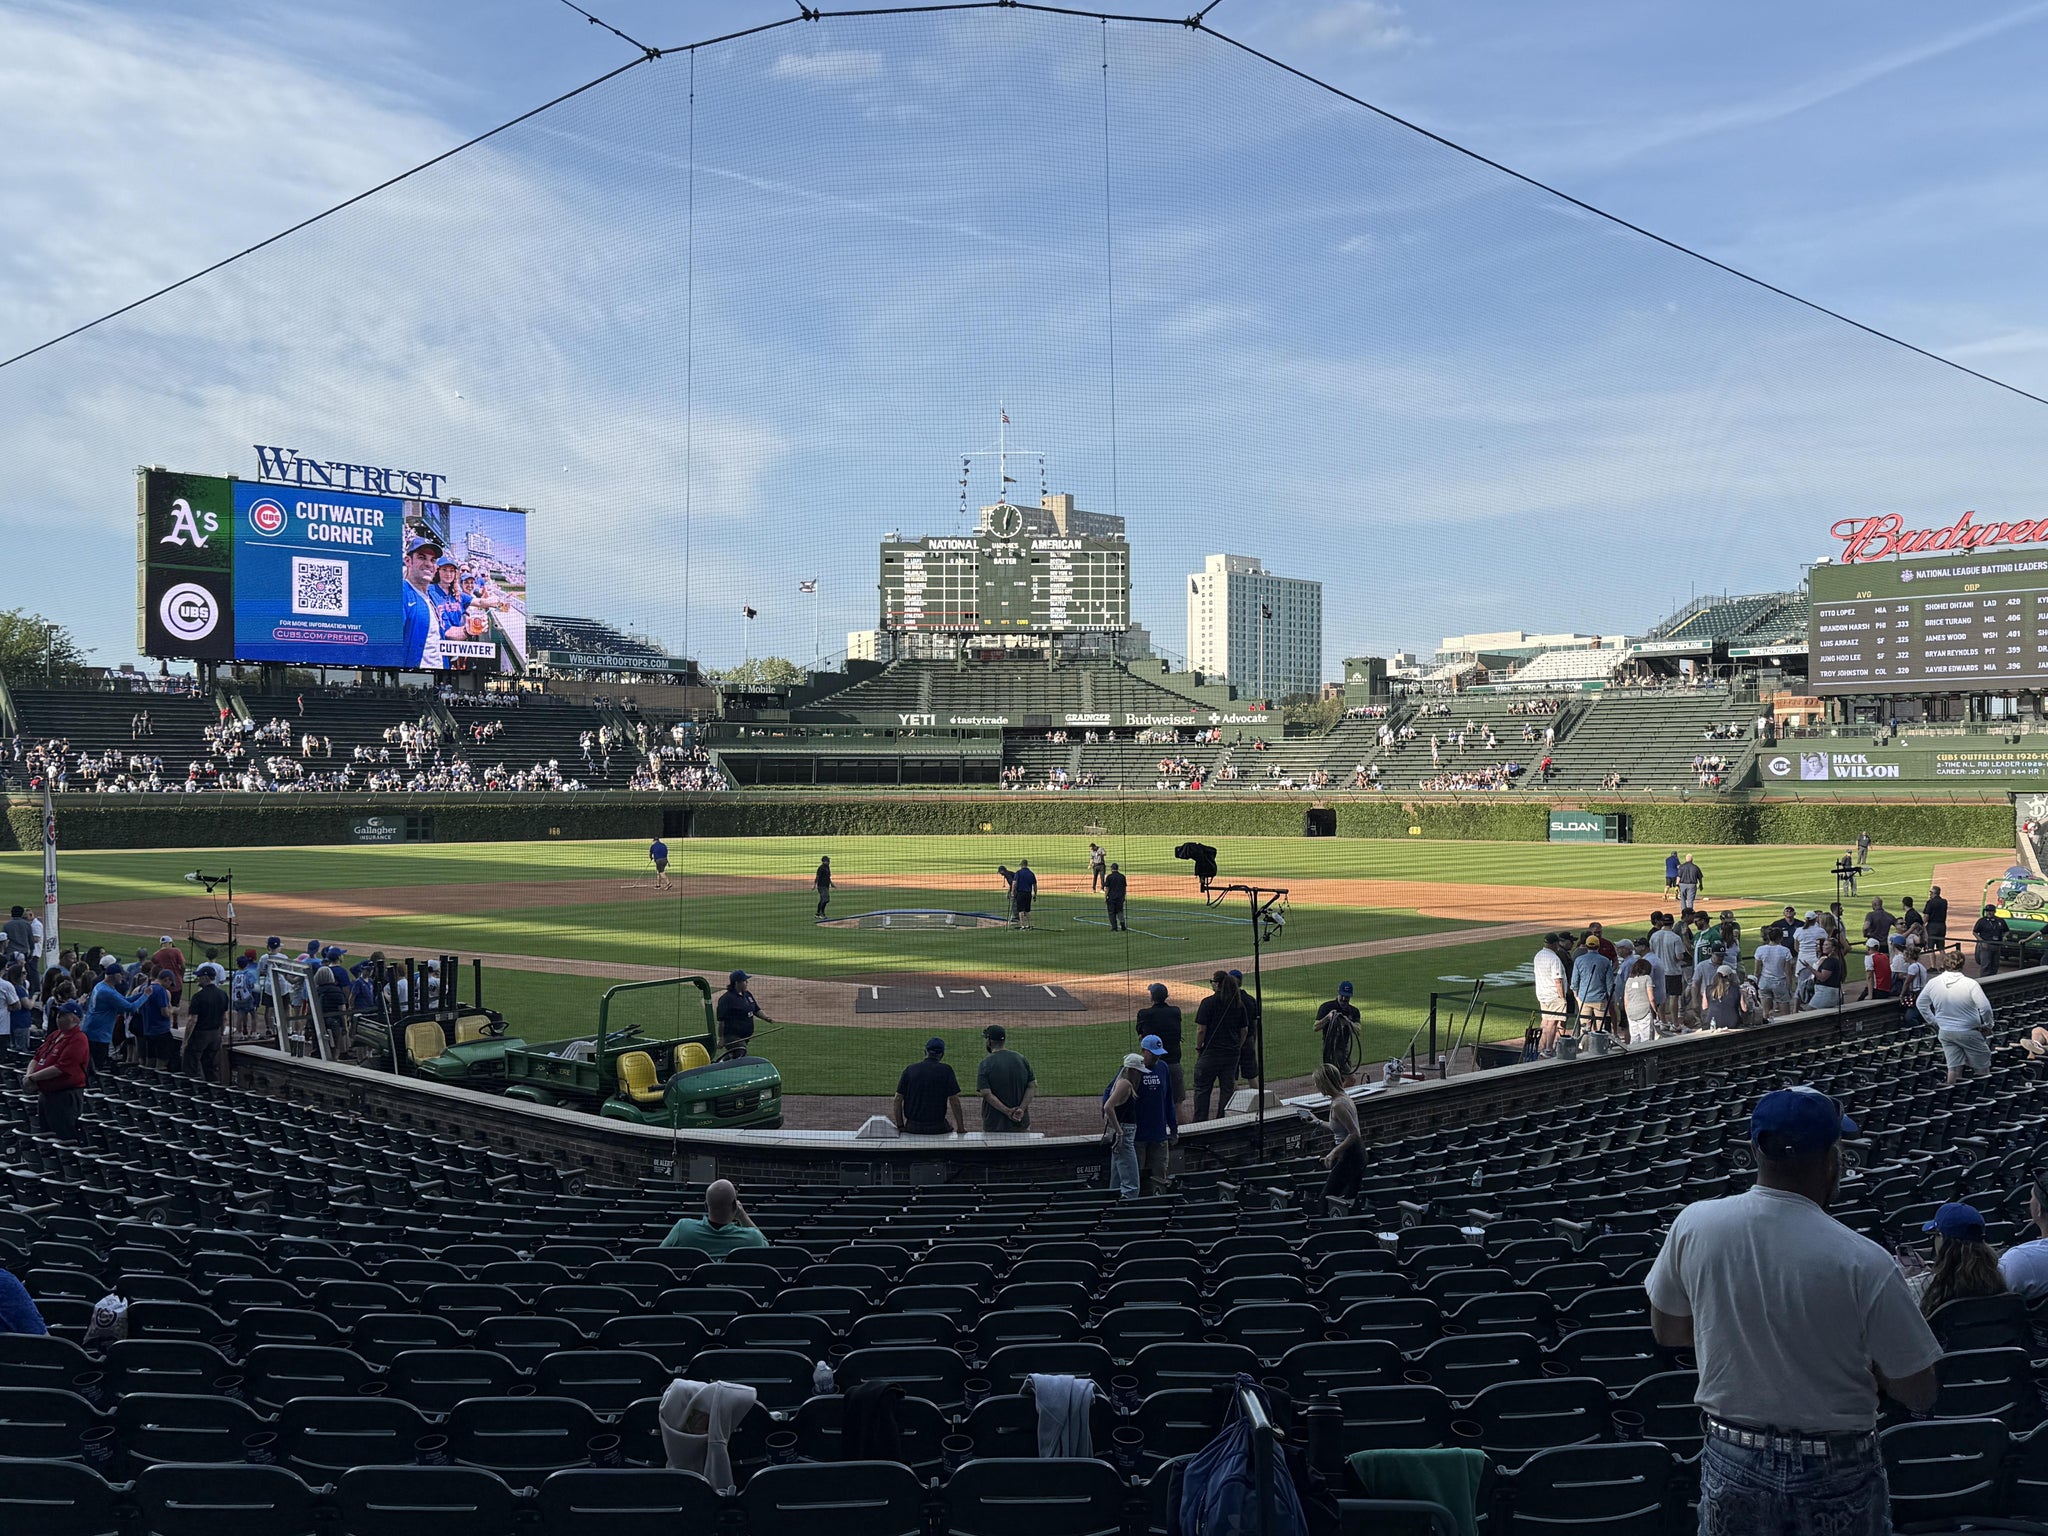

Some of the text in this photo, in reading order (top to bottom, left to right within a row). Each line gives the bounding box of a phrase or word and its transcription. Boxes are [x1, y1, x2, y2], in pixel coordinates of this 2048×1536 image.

[296, 502, 384, 527] CUTWATER
[308, 523, 373, 546] CORNER
[929, 540, 979, 550] NATIONAL
[1031, 540, 1082, 550] AMERICAN
[1916, 561, 2048, 579] NATIONAL LEAGUE BATTING LEADERS
[277, 630, 364, 641] CUBS.COM/PREMIER
[440, 643, 491, 655] CUTWATER
[569, 654, 668, 668] WRIGLEYROOFTOPS.COM
[898, 714, 936, 726] YETI
[957, 716, 1008, 726] tastytrade
[1065, 714, 1111, 722] GRAINGER
[1222, 714, 1268, 723] Advocate
[1833, 754, 1868, 763] HACK
[1834, 766, 1899, 777] WILSON
[354, 826, 397, 834] Gallagher
